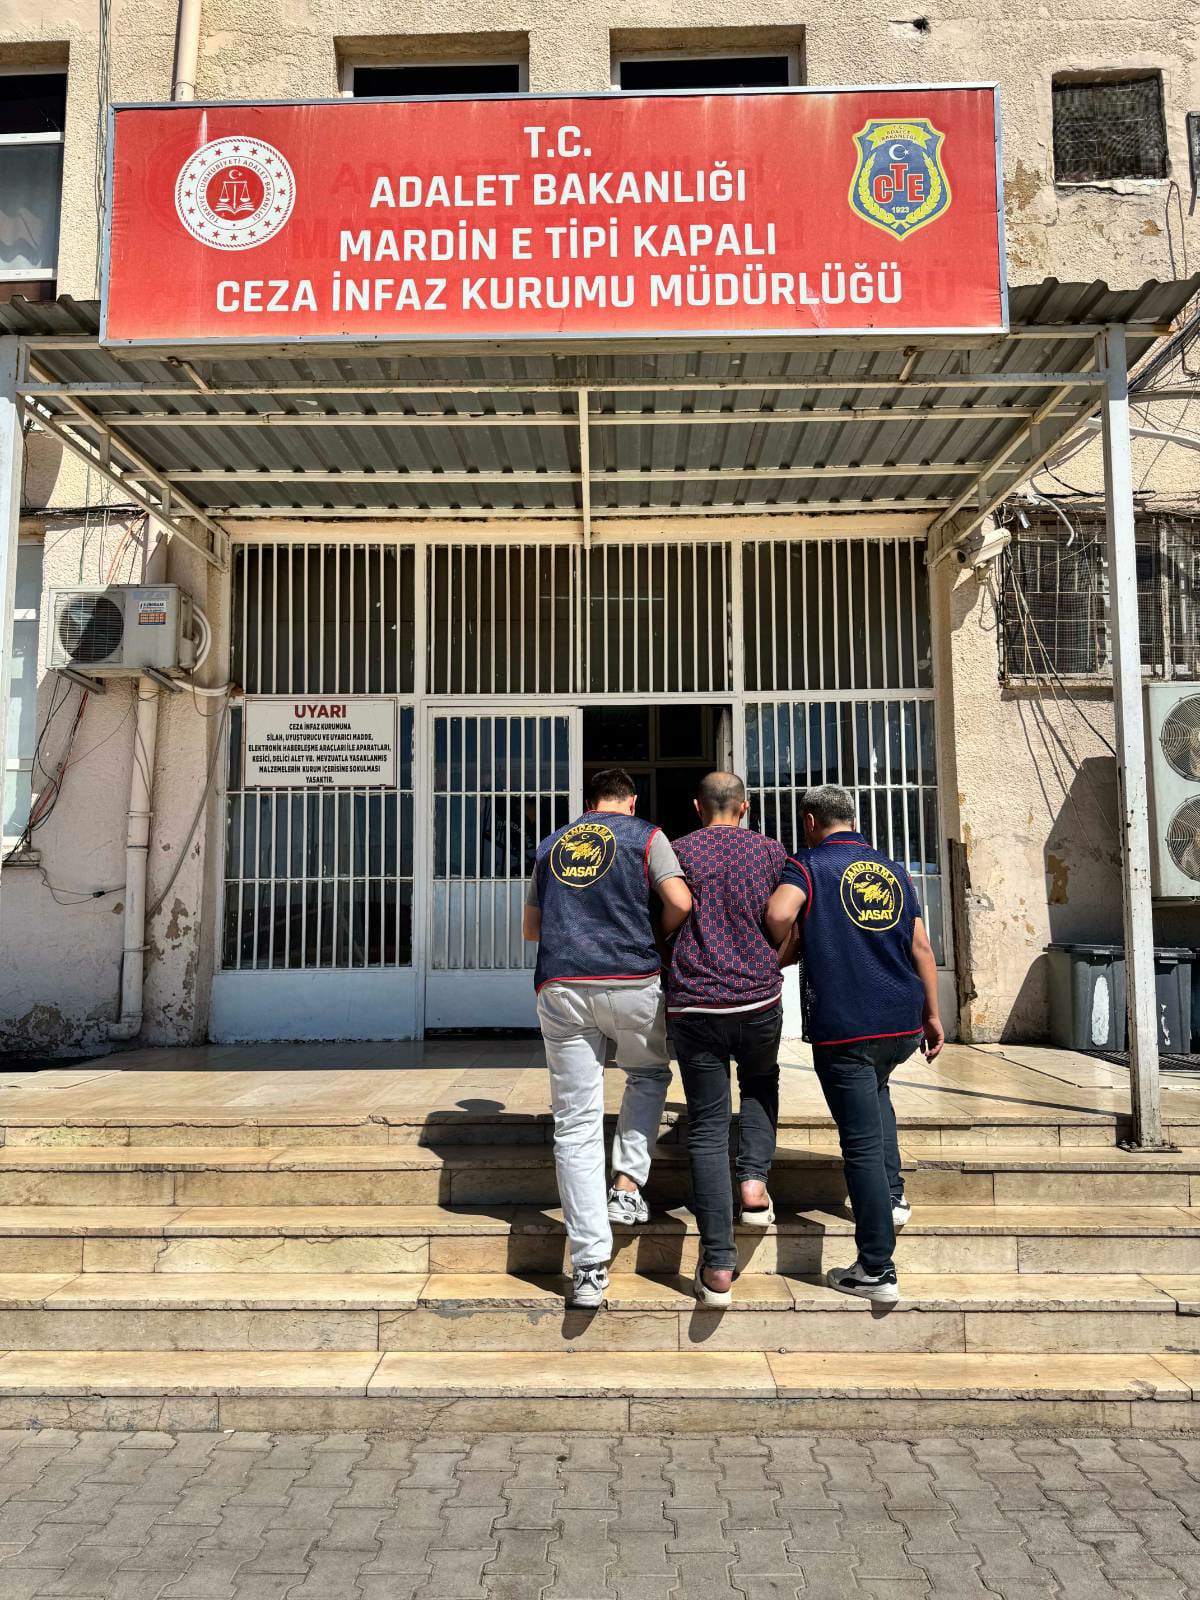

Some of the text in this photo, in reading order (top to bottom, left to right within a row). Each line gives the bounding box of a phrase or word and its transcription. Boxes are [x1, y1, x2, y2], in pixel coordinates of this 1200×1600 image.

[523, 126, 592, 158] T.C.
[369, 161, 746, 208] ADALET BAKANLIĞI
[340, 217, 776, 262] MARDİN E TİPİ KAPALI
[216, 262, 902, 313] CEZA İNFAZ KURUMU MÜDÜRLÜĞÜ
[294, 704, 347, 719] UYARI
[288, 721, 351, 731] CEZA İNFAZ KURUMUNA
[323, 733, 330, 741] VE
[330, 733, 352, 741] UYARICI
[352, 733, 374, 742] MADDE,
[248, 743, 283, 752] ELEKTRONİK
[290, 755, 305, 763] ALET
[258, 764, 301, 773] MALZEMELERİN
[349, 765, 381, 773] SOKULMASI
[561, 866, 600, 878] JASAT
[844, 862, 897, 885] JANDARMA
[857, 909, 894, 922] JASAT
